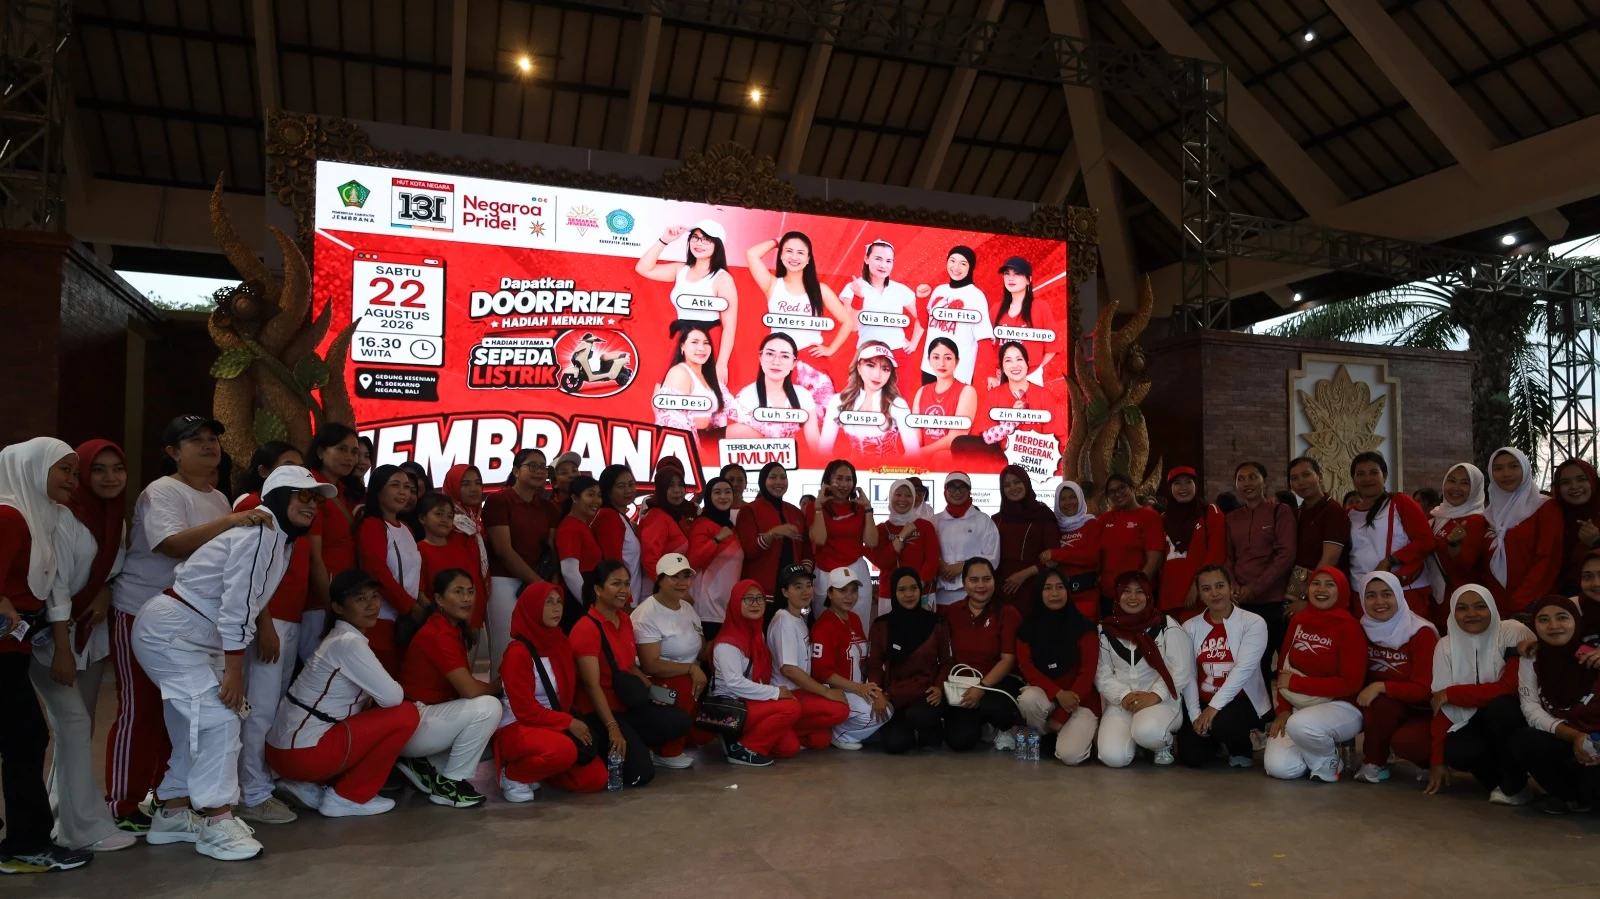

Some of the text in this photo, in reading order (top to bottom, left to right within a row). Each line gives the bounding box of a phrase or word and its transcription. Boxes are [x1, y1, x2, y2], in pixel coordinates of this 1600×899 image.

[426, 182, 451, 190] NEGARA
[463, 194, 542, 218] Negaroa
[331, 214, 375, 224] JEMBRANA
[463, 211, 517, 232] Pride!
[375, 265, 421, 278] SABTU
[501, 277, 574, 292] Dapatkan
[369, 276, 426, 309] 22
[470, 290, 632, 318] DOORPRIZE
[691, 298, 714, 308] Atik
[778, 300, 801, 313] Red
[364, 307, 430, 321] AGUSTUS
[861, 313, 908, 325] Nia Rose
[938, 310, 976, 321] Zin Fita
[380, 319, 414, 330] 2026
[501, 315, 604, 328] HADIAH MENARIK
[766, 316, 828, 328] D Mers Juli
[997, 328, 1052, 341] D Mers Jupe
[358, 336, 402, 349] 16.30
[360, 348, 392, 358] WITA
[474, 348, 554, 366] SEPEDA
[375, 373, 436, 382] GEDUNG KESENIAN
[472, 366, 557, 386] LISTRIK
[658, 397, 707, 408] Zin Desi
[761, 410, 801, 420] Luh Sri
[846, 413, 878, 423] Puspa
[999, 410, 1042, 420] Zin Ratna
[914, 417, 963, 427] Zin Arsani
[762, 443, 791, 451] UNTUK
[1015, 434, 1054, 450] MERDEKA
[728, 451, 790, 465] UMUM!
[1013, 443, 1054, 461] BERGERAK,
[1020, 455, 1042, 466] SEHAT
[1296, 629, 1333, 647] Reebok
